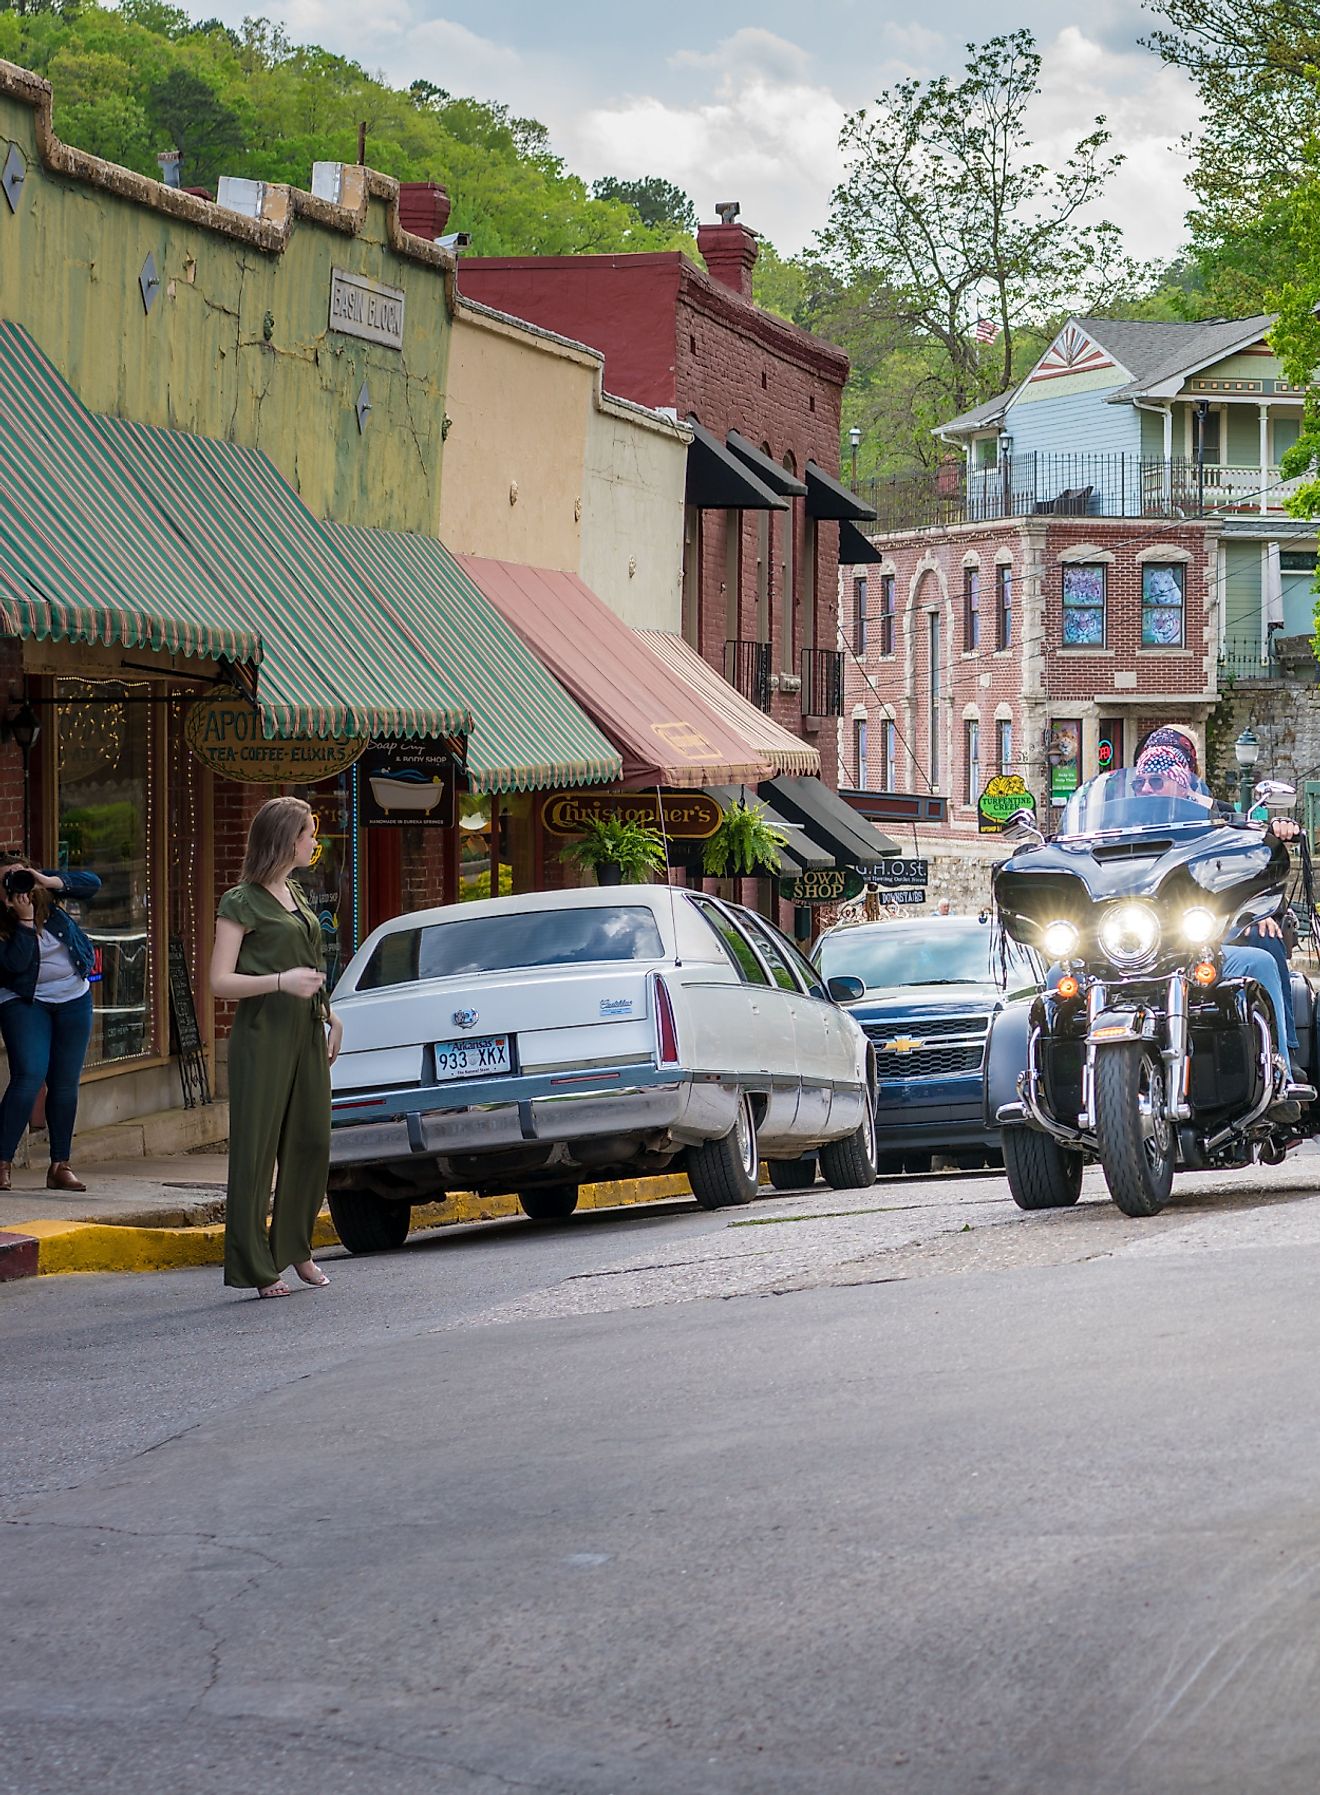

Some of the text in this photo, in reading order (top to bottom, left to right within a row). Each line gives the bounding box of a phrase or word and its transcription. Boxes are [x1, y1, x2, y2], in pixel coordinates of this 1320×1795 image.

[333, 284, 400, 335] BASIN BLOCK
[982, 797, 1032, 805] TURPENTINE
[552, 797, 712, 827] Christopher's
[793, 884, 844, 898] SHOP
[881, 891, 923, 904] DOWNSTAIRS
[452, 1039, 492, 1051] Arkansas
[439, 1046, 506, 1071] 933 XKX
